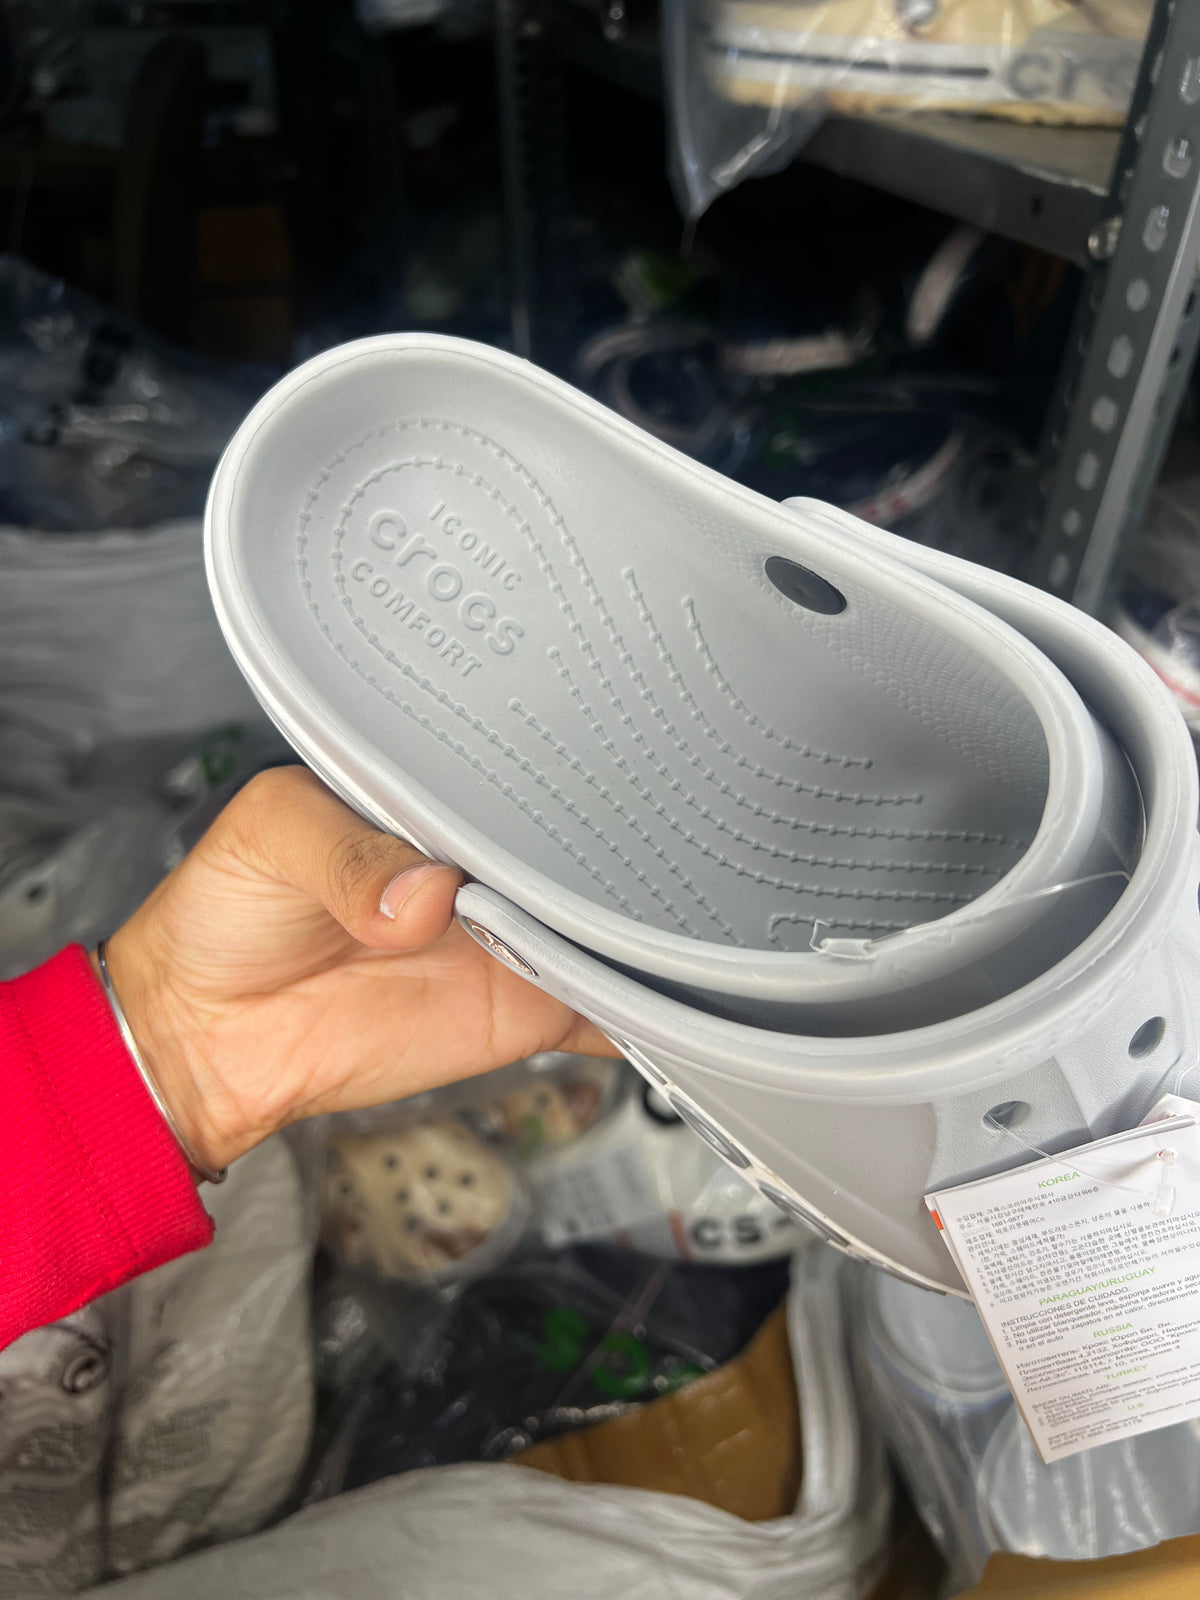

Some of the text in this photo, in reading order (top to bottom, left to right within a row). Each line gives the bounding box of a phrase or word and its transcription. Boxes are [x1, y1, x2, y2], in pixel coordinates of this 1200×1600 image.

[429, 503, 522, 591] ICONIC
[368, 509, 525, 656] crocs
[351, 558, 482, 678] COMFORT
[1037, 1171, 1080, 1188] KOREA
[1010, 1321, 1036, 1332] Limpia
[1037, 1316, 1053, 1324] con
[1054, 1304, 1096, 1319] detergente
[1118, 1288, 1150, 1301] esponja
[1151, 1281, 1175, 1291] suave
[1039, 1267, 1154, 1305] PARAGUAY/URUGUAY
[1001, 1303, 1071, 1327] INSTRUCCIONES
[1026, 1324, 1051, 1334] utilizar
[1105, 1299, 1139, 1312] máquina
[1140, 1288, 1175, 1302] lavadora
[1028, 1330, 1056, 1342] guarde
[1071, 1317, 1102, 1329] zapatos
[1147, 1289, 1197, 1307] directamente
[1092, 1322, 1133, 1338] RUSSIA
[1106, 1364, 1147, 1380] TURKEY
